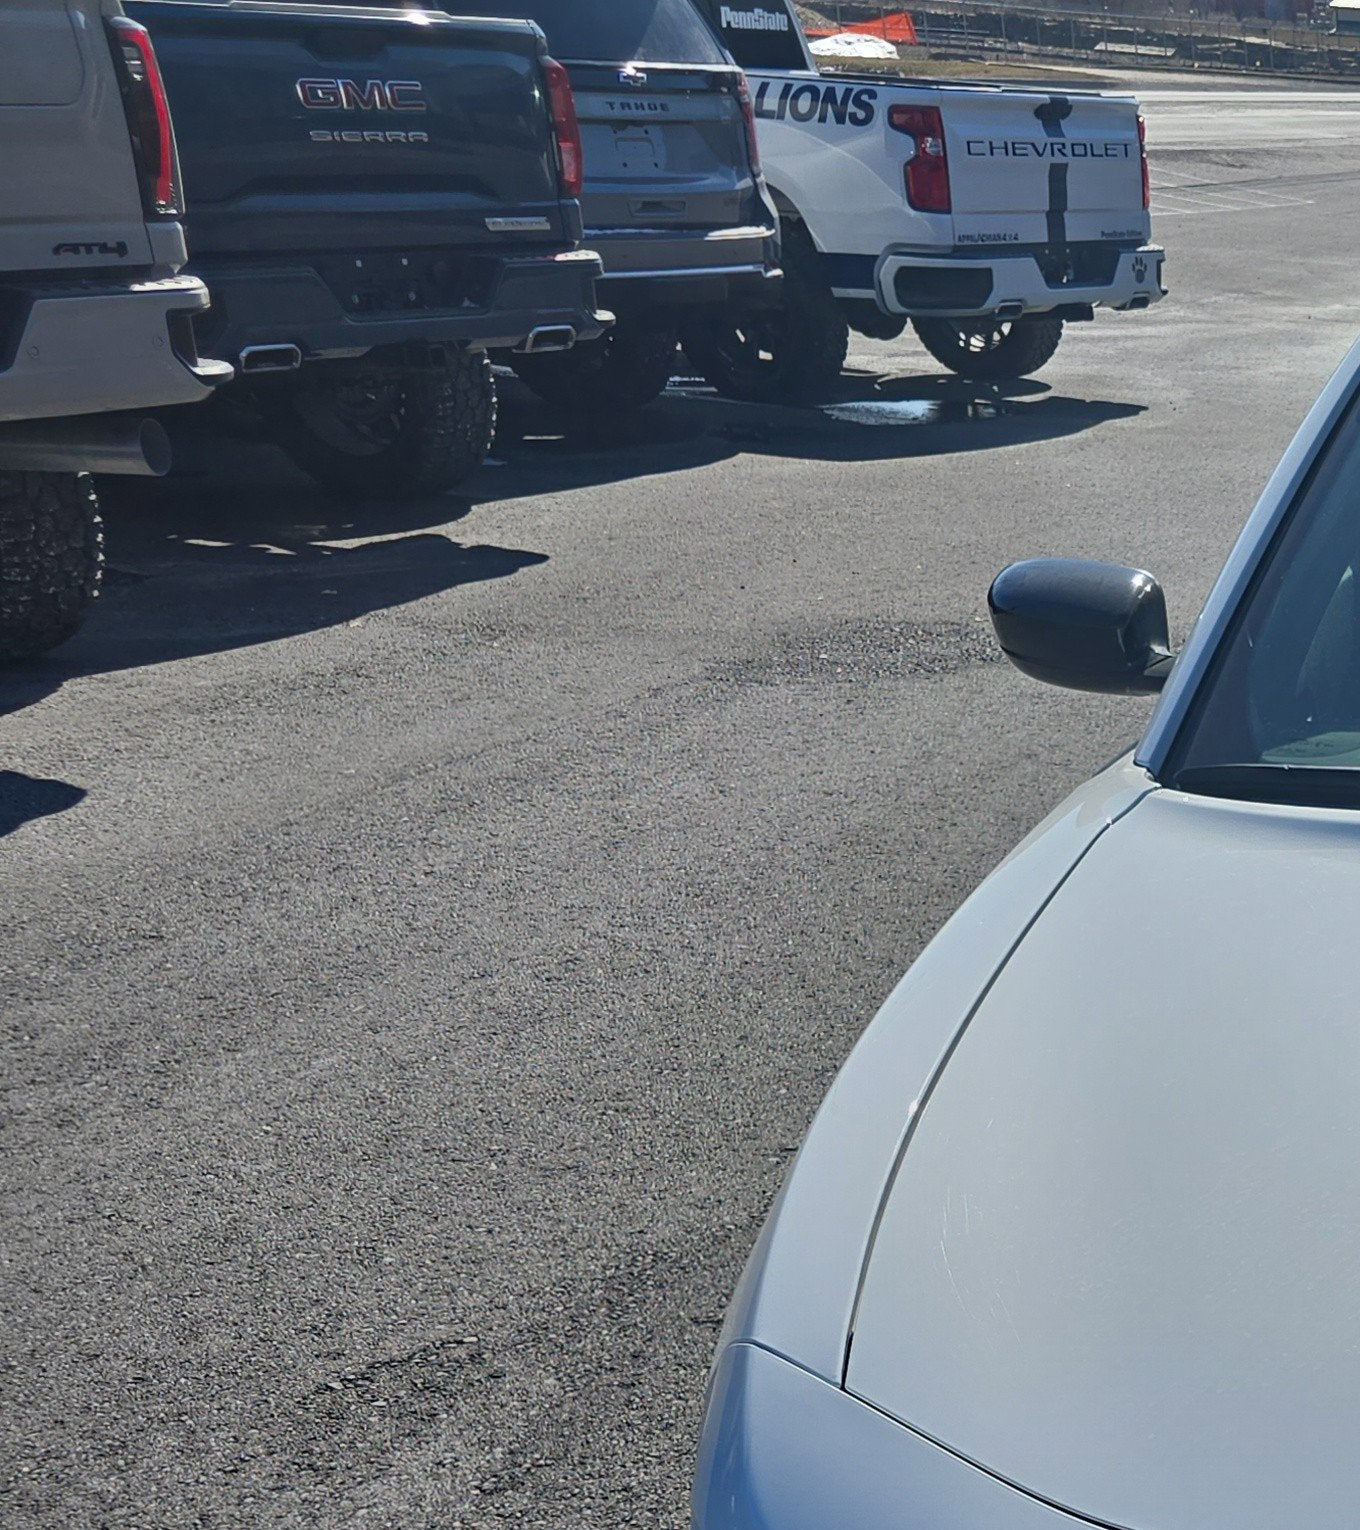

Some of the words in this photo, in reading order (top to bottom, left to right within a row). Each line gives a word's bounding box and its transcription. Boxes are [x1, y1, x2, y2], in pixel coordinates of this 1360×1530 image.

[295, 78, 427, 110] GMC
[754, 81, 878, 127] LIONS
[309, 130, 429, 143] SIERRA
[966, 140, 1132, 158] CHEVROLET
[52, 241, 128, 258] AT4
